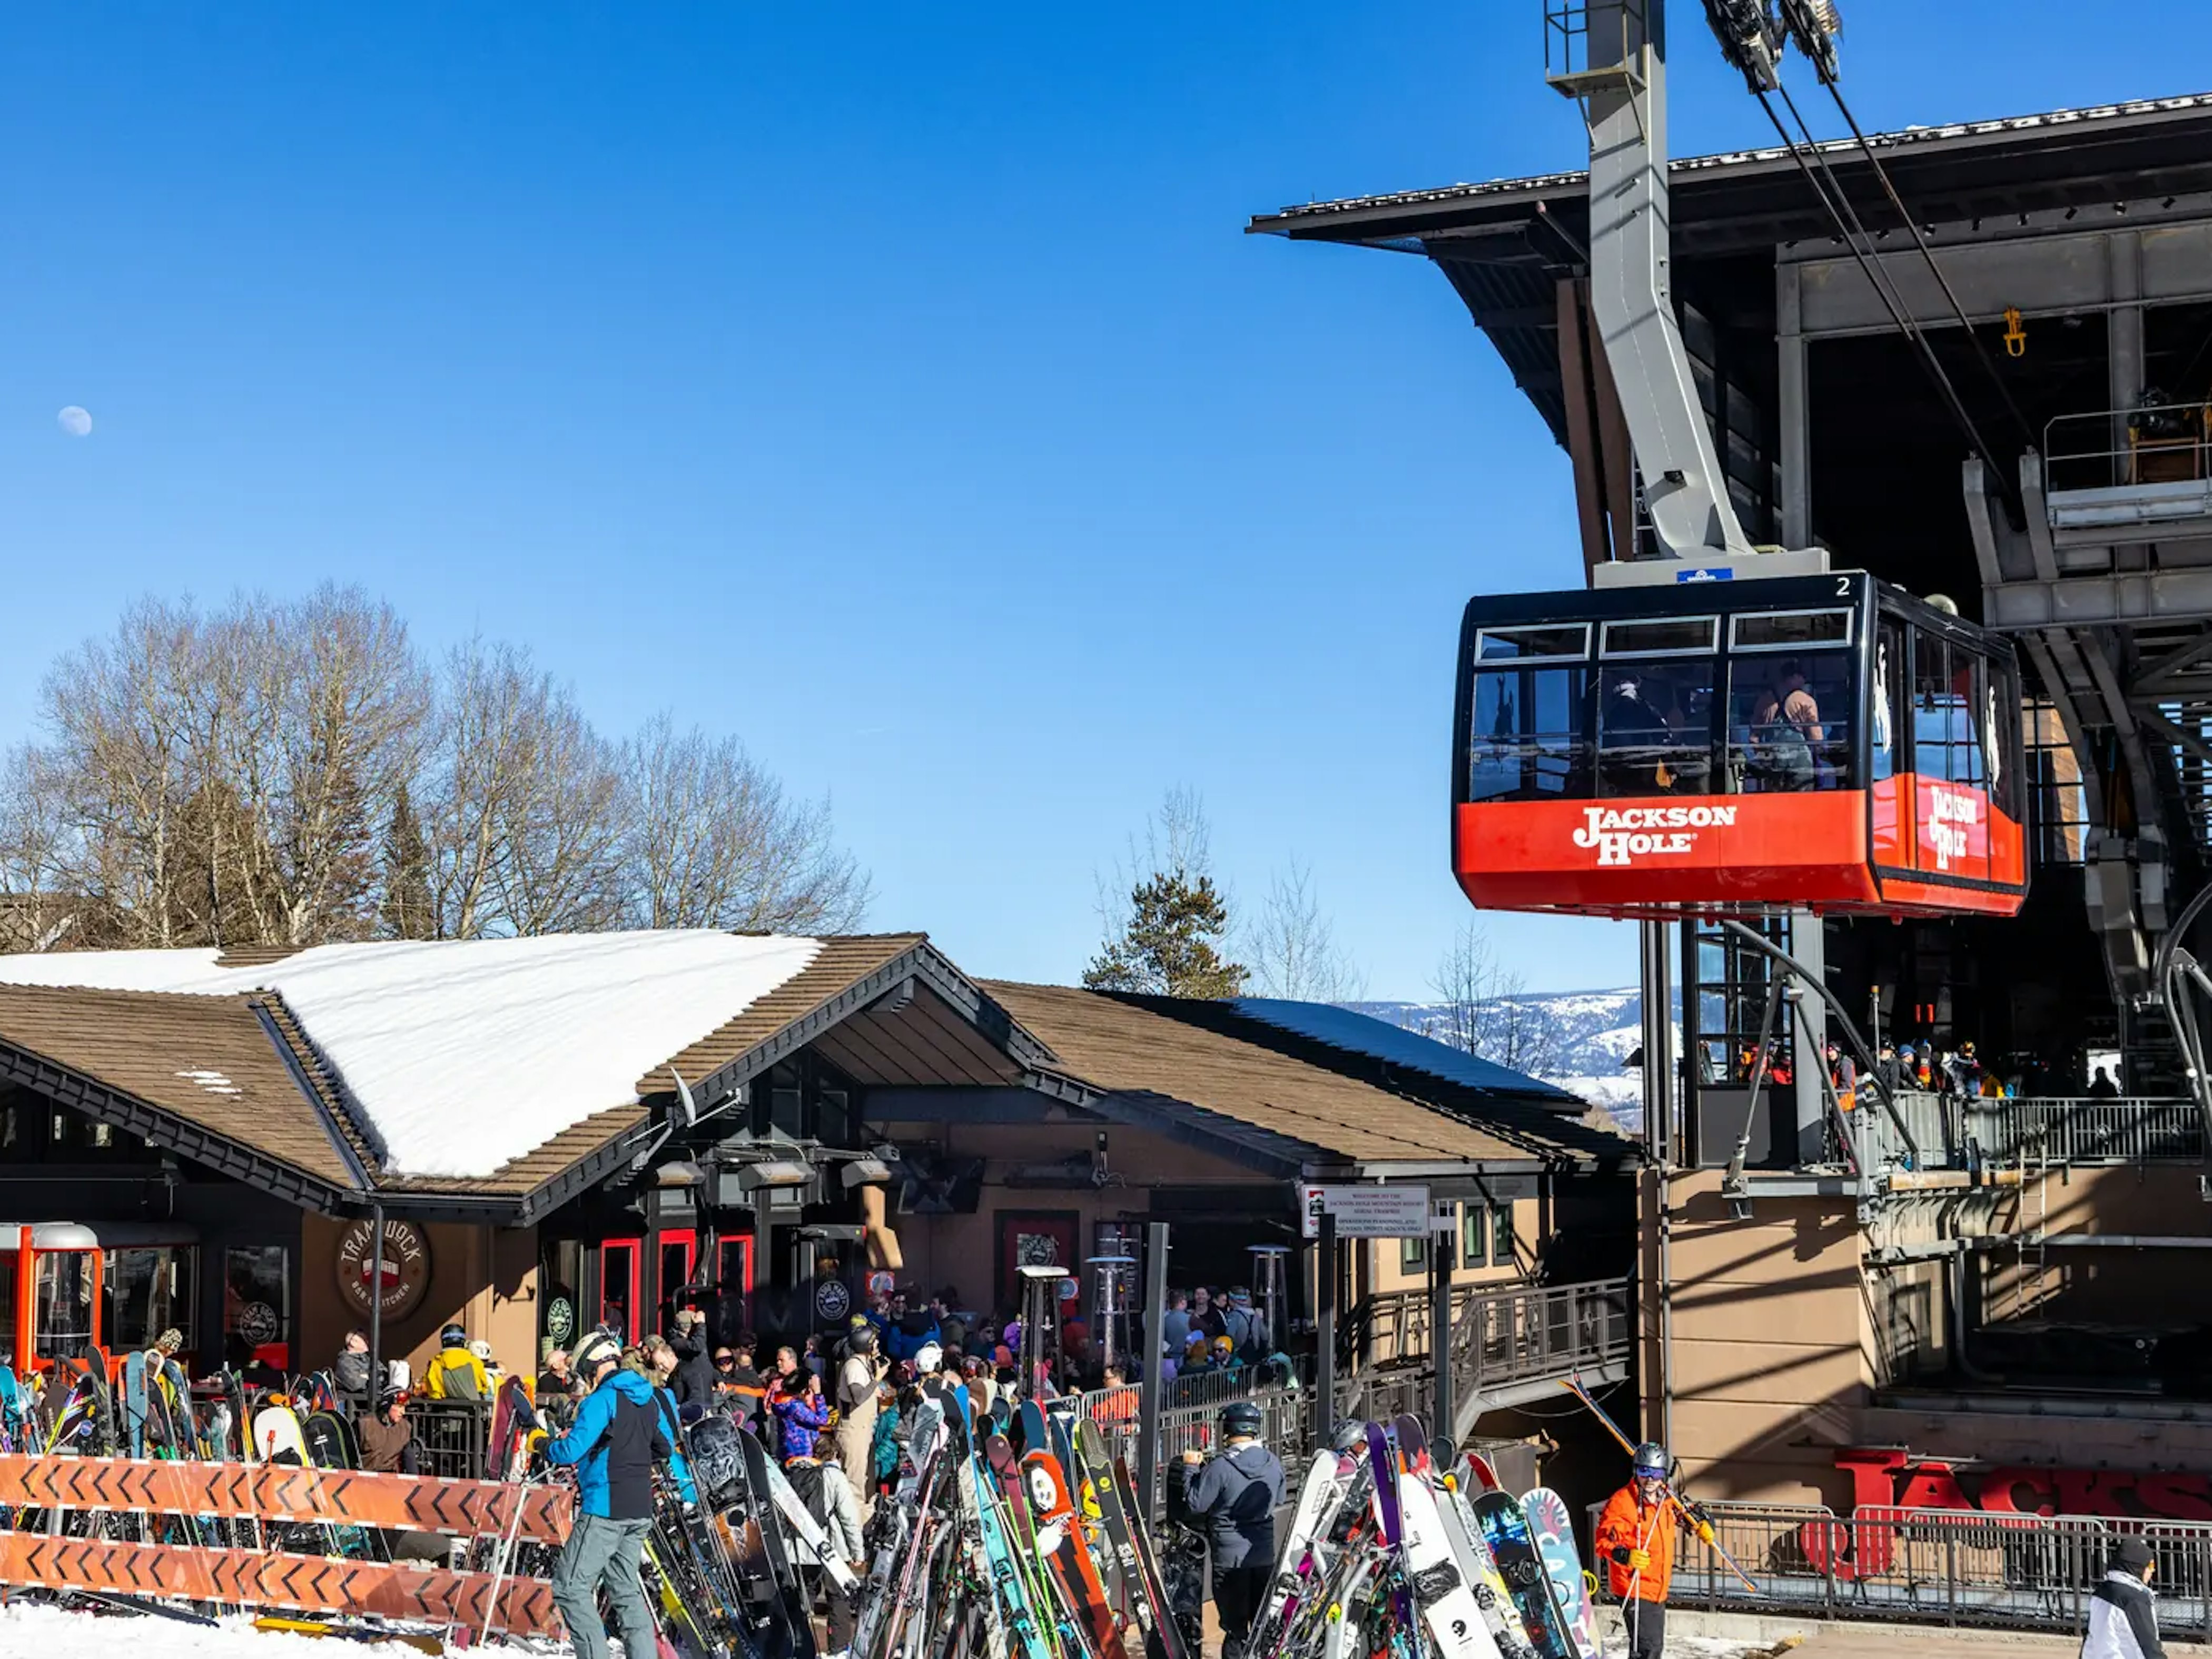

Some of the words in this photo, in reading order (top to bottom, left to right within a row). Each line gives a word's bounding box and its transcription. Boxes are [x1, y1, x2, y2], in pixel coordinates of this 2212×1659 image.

[1836, 577, 1850, 596] 2
[1573, 806, 1737, 848] JACKSON
[381, 1282, 410, 1308] ITCHEN
